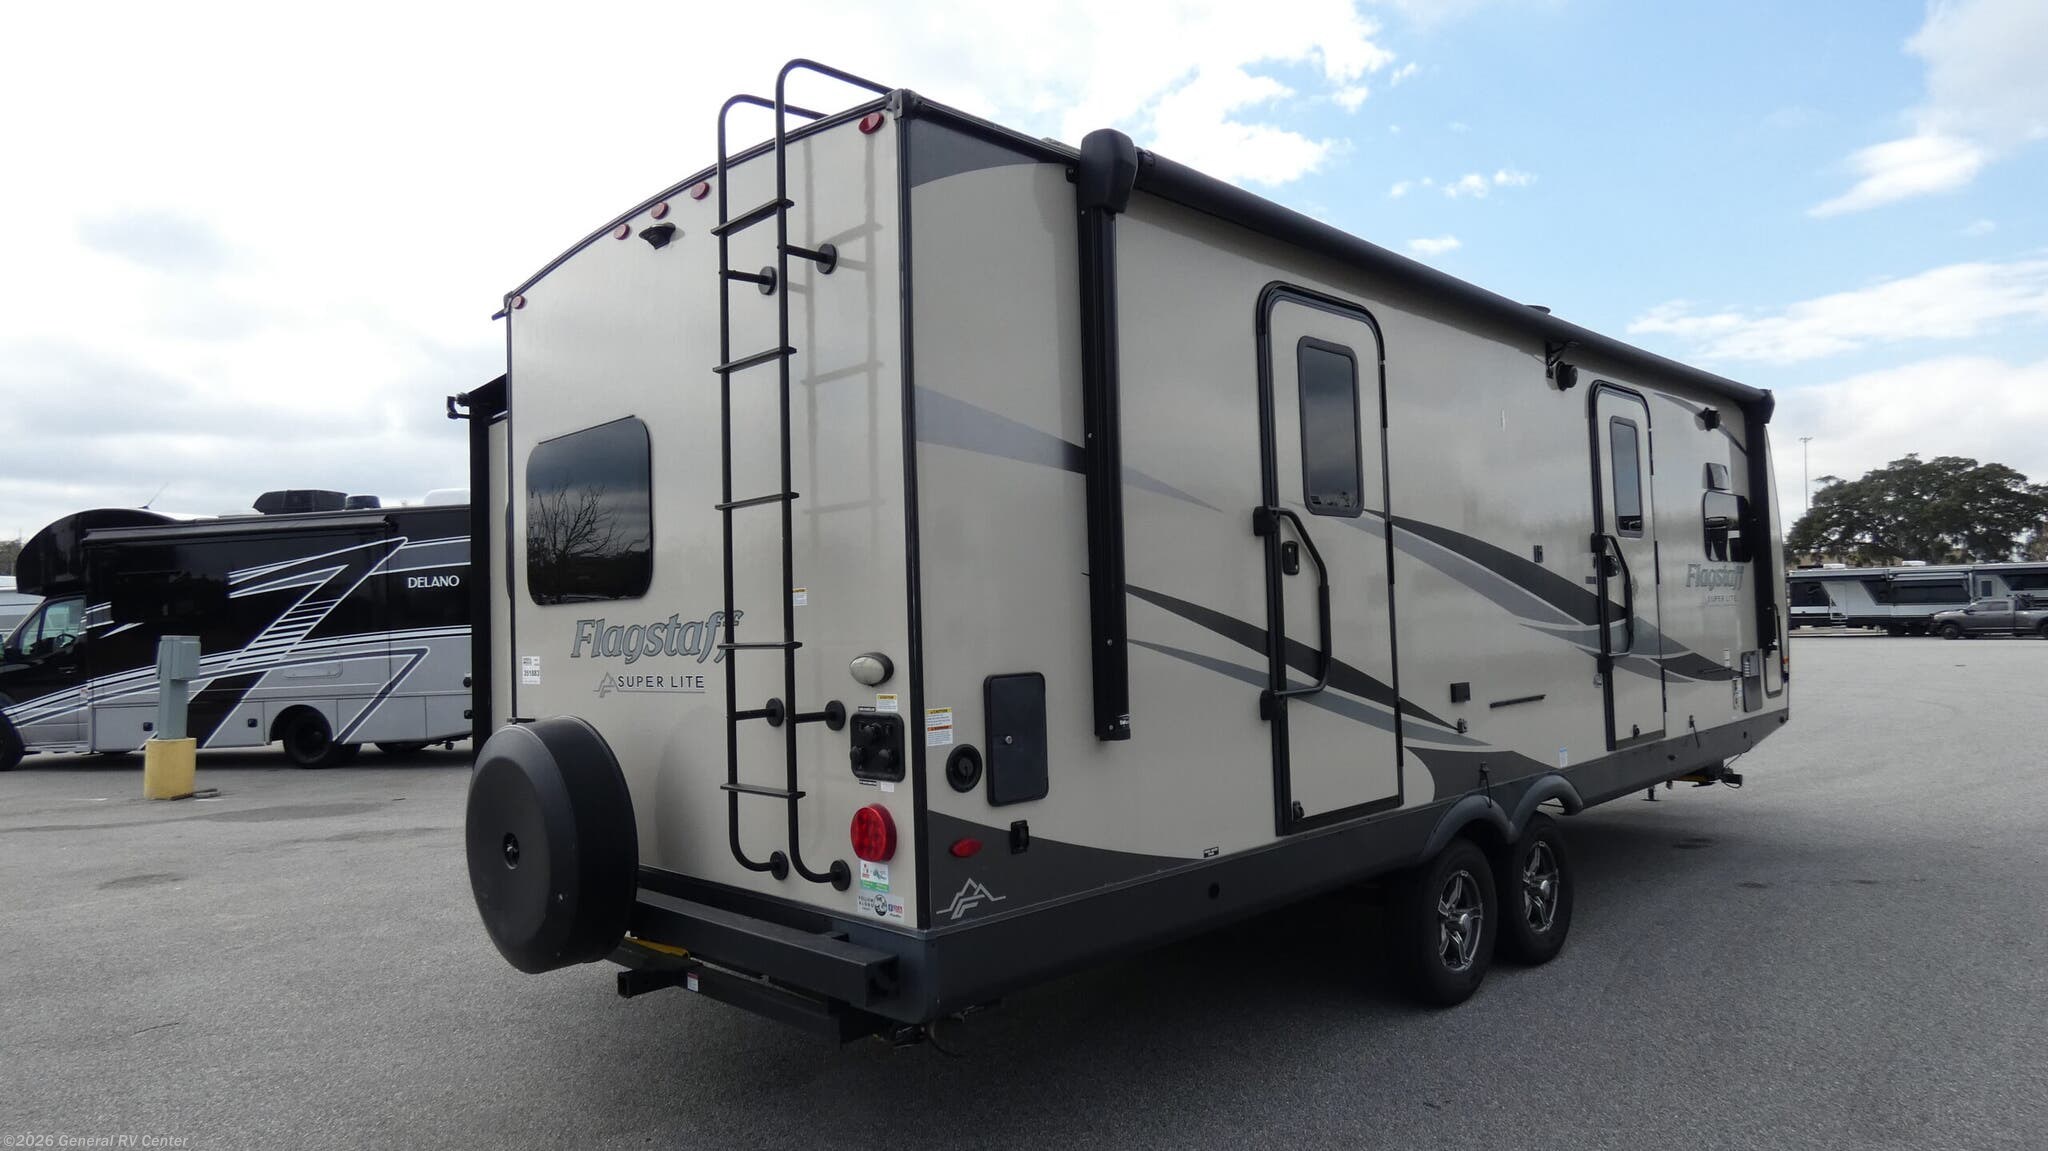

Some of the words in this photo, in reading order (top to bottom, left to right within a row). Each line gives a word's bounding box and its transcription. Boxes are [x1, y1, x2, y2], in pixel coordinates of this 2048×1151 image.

[407, 575, 460, 589] DELANO
[1685, 563, 1744, 592] Flagstaff
[618, 675, 664, 688] SUPER
[671, 676, 704, 688] LITE
